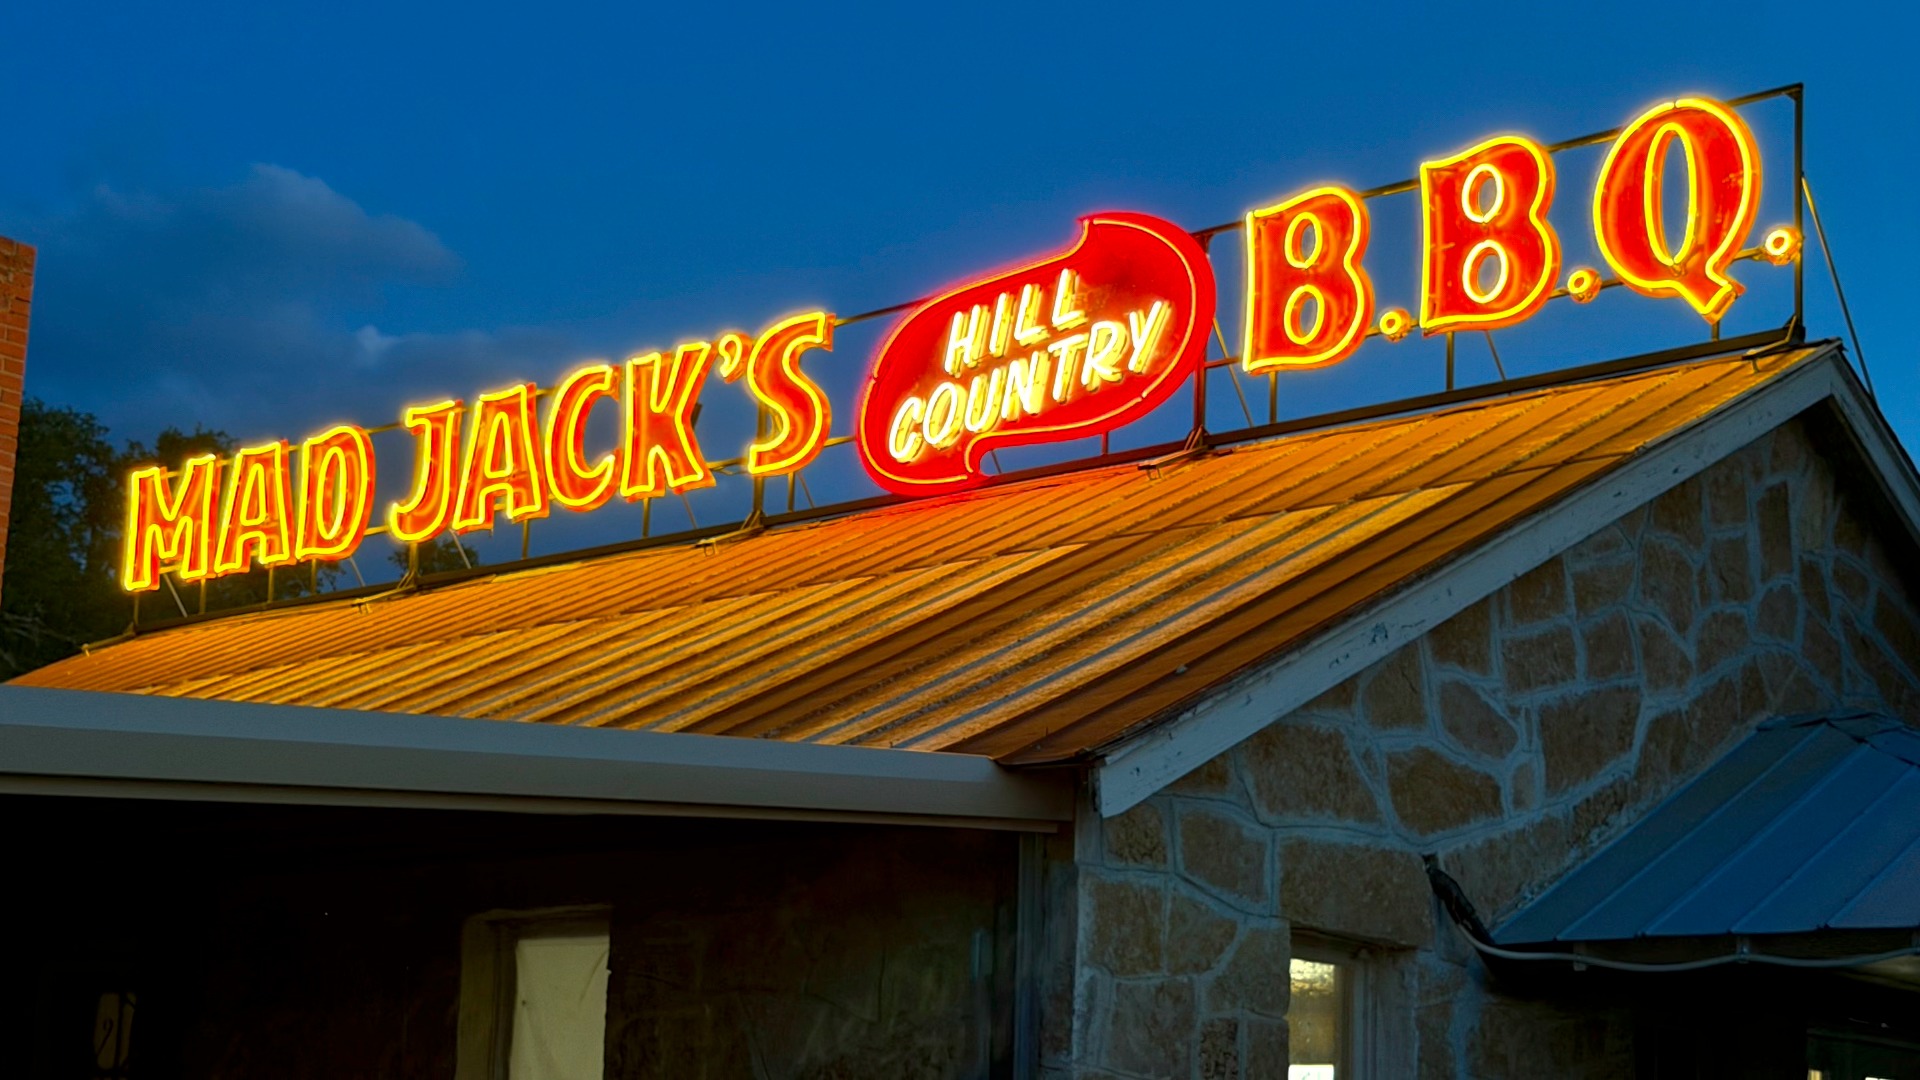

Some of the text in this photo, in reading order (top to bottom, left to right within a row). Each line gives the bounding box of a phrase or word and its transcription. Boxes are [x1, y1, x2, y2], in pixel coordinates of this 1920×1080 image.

[943, 267, 1088, 378] HILL
[1243, 97, 1801, 375] B.B.Q.
[125, 311, 837, 592] MAD JACK'S
[888, 299, 1171, 463] COUNTRY
